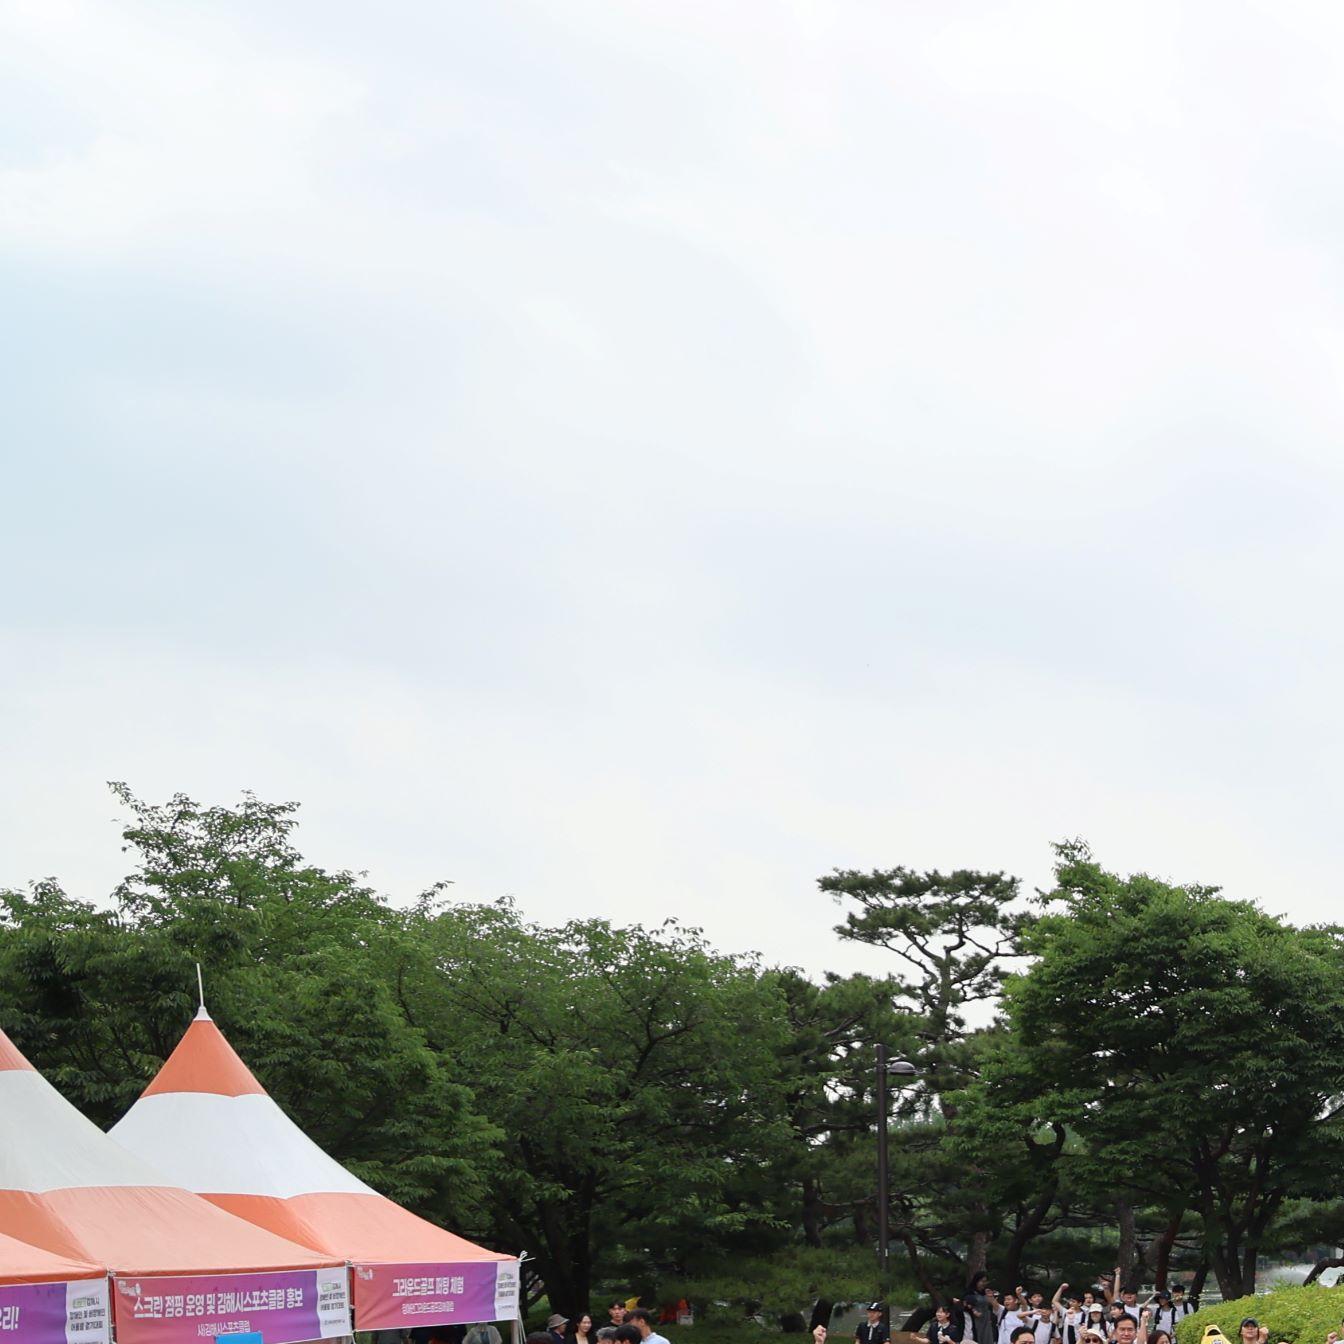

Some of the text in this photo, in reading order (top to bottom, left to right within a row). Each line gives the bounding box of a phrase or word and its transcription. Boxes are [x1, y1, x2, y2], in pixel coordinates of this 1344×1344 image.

[393, 1278, 434, 1297] 그라운드골프
[134, 1296, 163, 1319] 스크린
[165, 1294, 184, 1317] 점핑
[186, 1293, 205, 1316] 운영
[217, 1289, 286, 1314] 김해시스포츠클럽
[287, 1287, 303, 1309] 홍보
